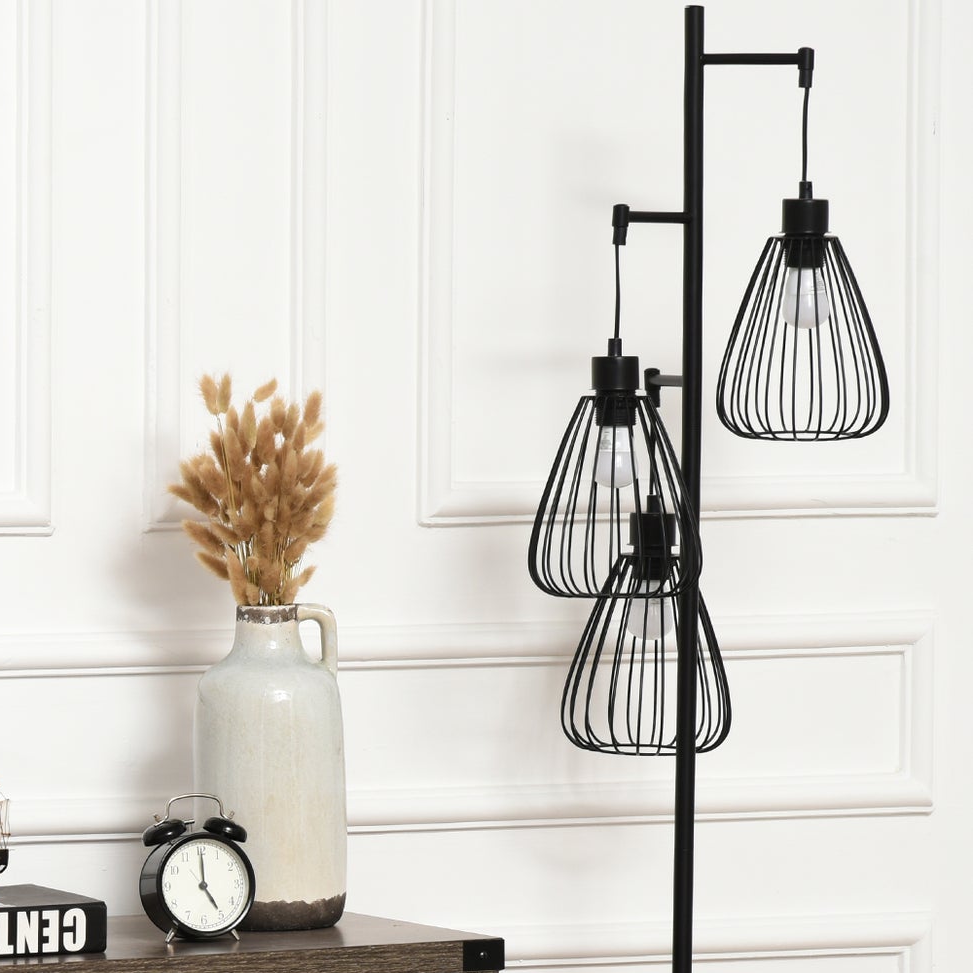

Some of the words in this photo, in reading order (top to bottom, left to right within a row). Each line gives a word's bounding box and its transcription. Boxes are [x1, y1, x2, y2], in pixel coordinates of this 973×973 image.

[197, 846, 206, 856] 12
[215, 850, 220, 860] 1
[181, 852, 189, 862] 11
[170, 865, 179, 875] 10
[227, 862, 234, 872] 2
[164, 882, 171, 892] 9
[234, 880, 240, 889] 3
[171, 900, 178, 909] 8
[228, 896, 235, 906] 4
[185, 910, 191, 920] 7
[201, 914, 207, 925] 6
[218, 910, 224, 920] 5
